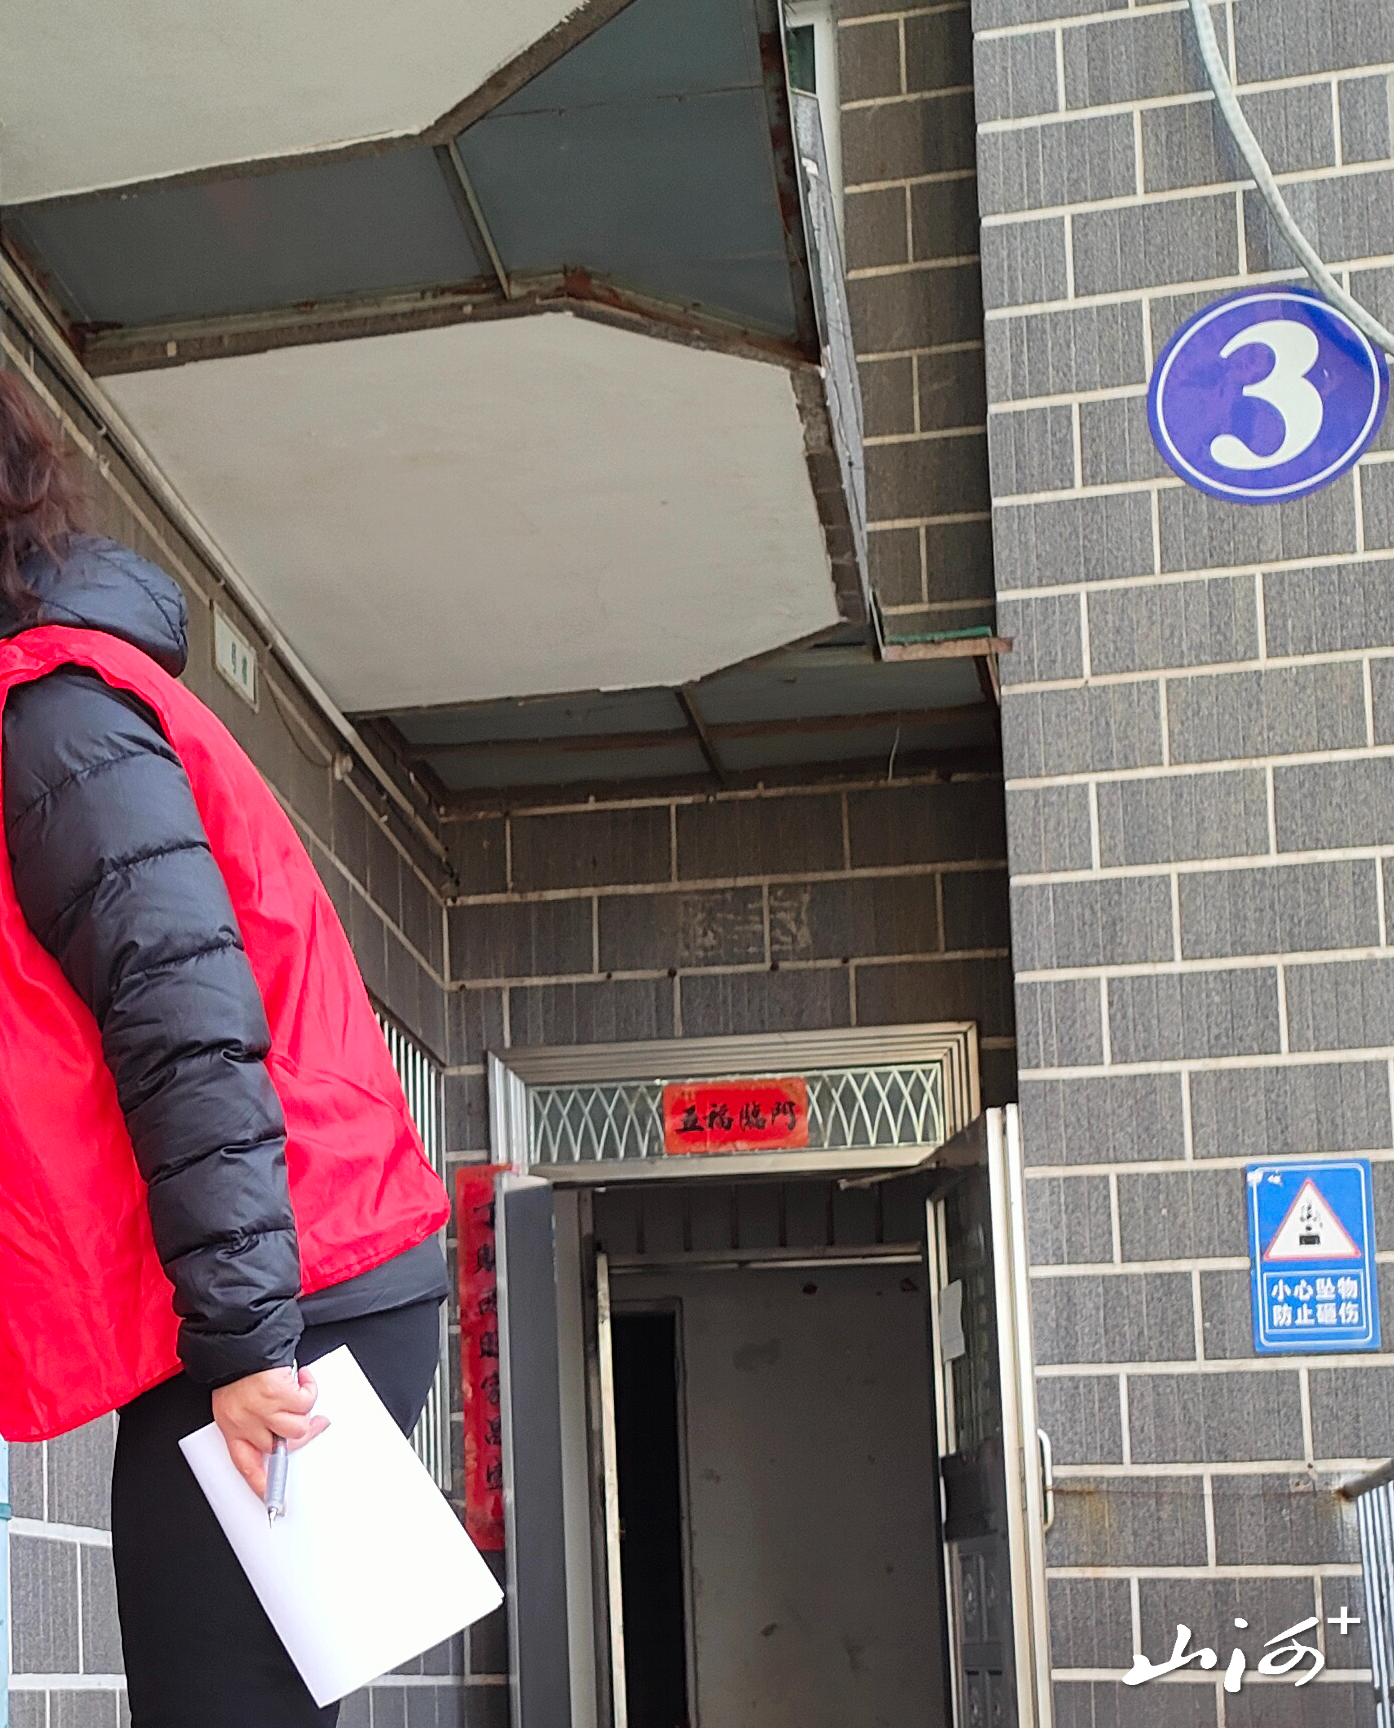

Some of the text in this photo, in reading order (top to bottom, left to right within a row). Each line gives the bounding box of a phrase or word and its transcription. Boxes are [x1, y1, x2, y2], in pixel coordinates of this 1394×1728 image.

[1210, 319, 1323, 470] 3
[1271, 1276, 1358, 1301] 小心坠物
[1272, 1301, 1359, 1327] 防止砸伤
